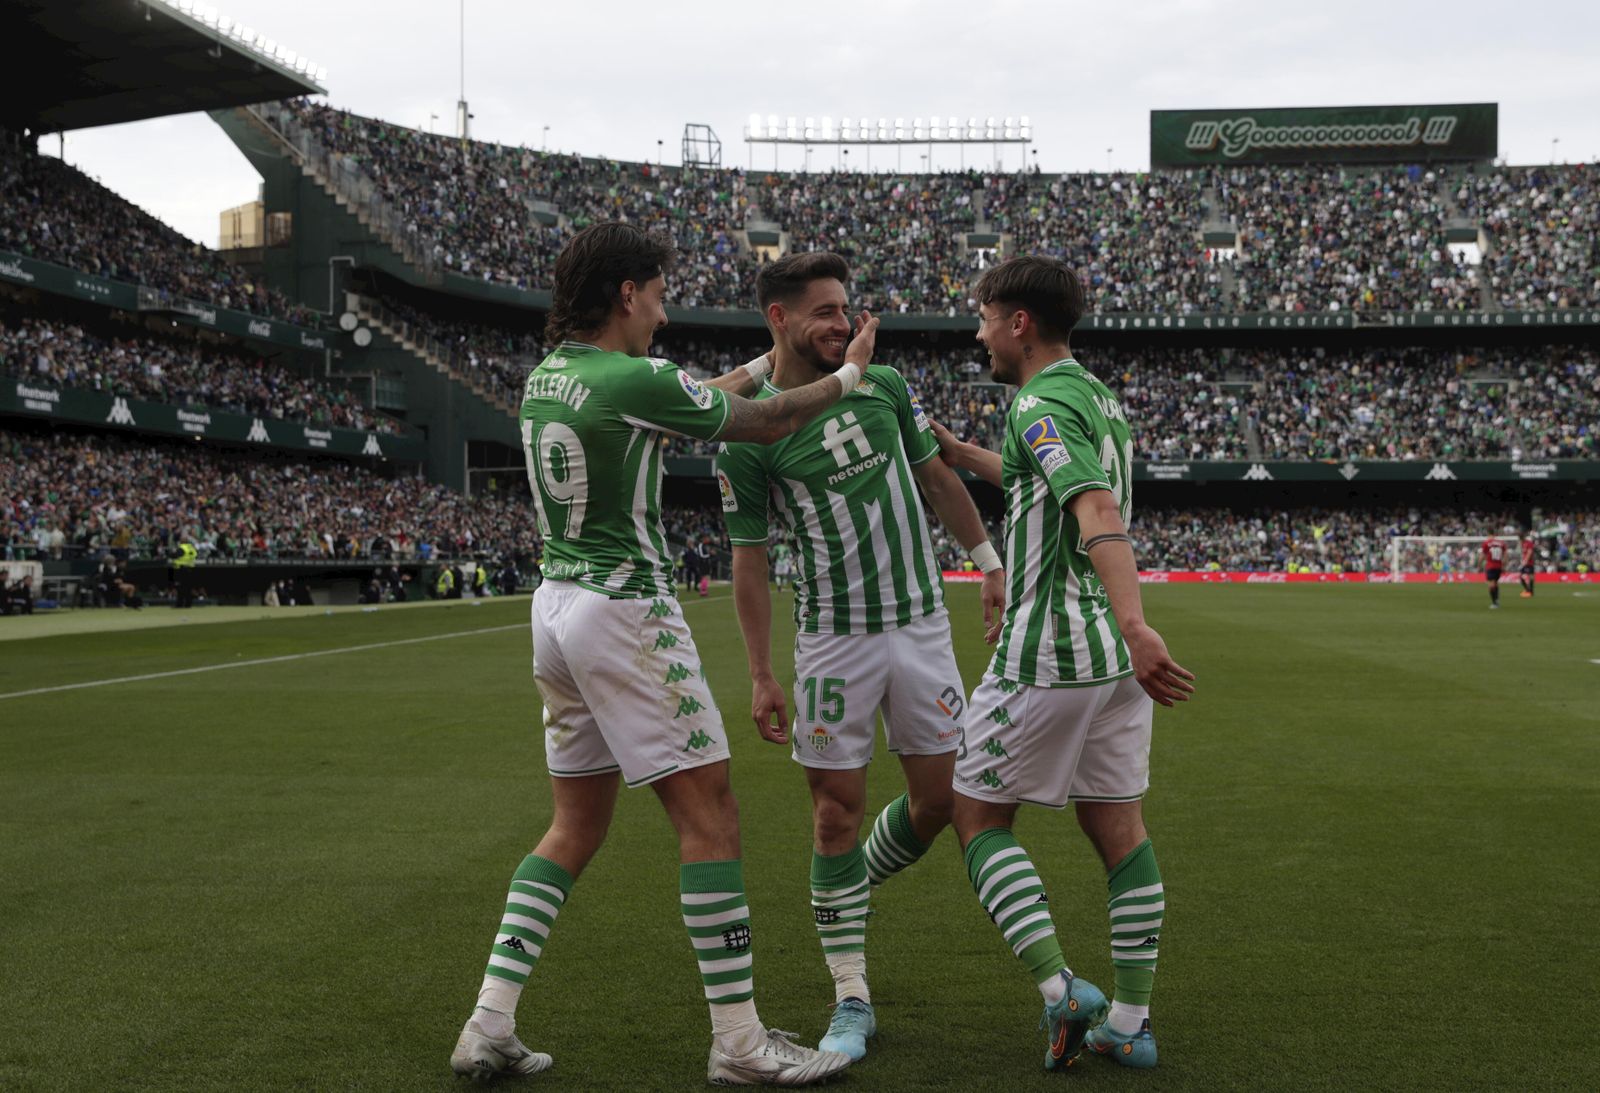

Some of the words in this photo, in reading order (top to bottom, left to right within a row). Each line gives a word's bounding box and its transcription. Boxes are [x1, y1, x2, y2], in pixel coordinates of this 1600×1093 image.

[1093, 316, 1186, 329] leyenda
[1203, 316, 1240, 329] que
[1257, 316, 1345, 328] recorre
[1434, 313, 1504, 325] mundo
[1522, 312, 1600, 325] entero
[16, 383, 60, 402] finetwork
[523, 373, 591, 412] ELLERÍN
[821, 411, 873, 468] fi
[522, 419, 589, 542] 19
[827, 451, 888, 486] network
[803, 677, 846, 724] 15
